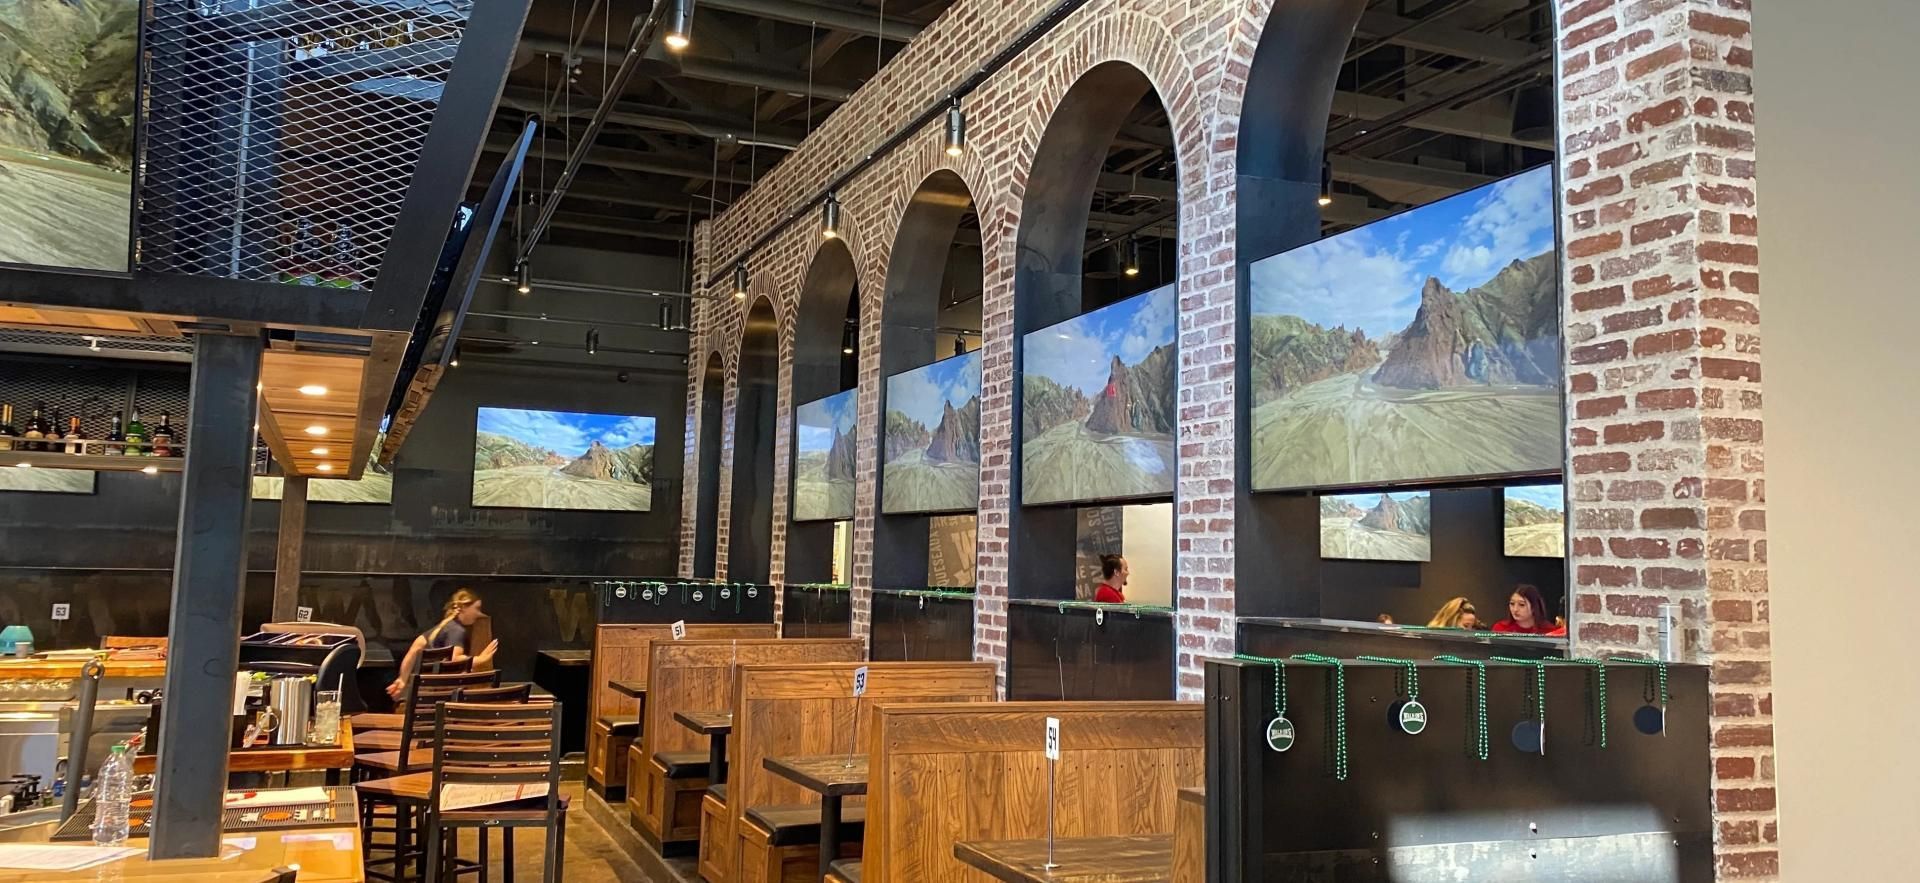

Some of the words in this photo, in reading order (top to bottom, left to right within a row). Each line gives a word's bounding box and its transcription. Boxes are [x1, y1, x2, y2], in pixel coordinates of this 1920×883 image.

[56, 607, 66, 616] 63
[299, 609, 308, 619] 62
[857, 673, 864, 690] 53
[1049, 727, 1056, 750] 54
